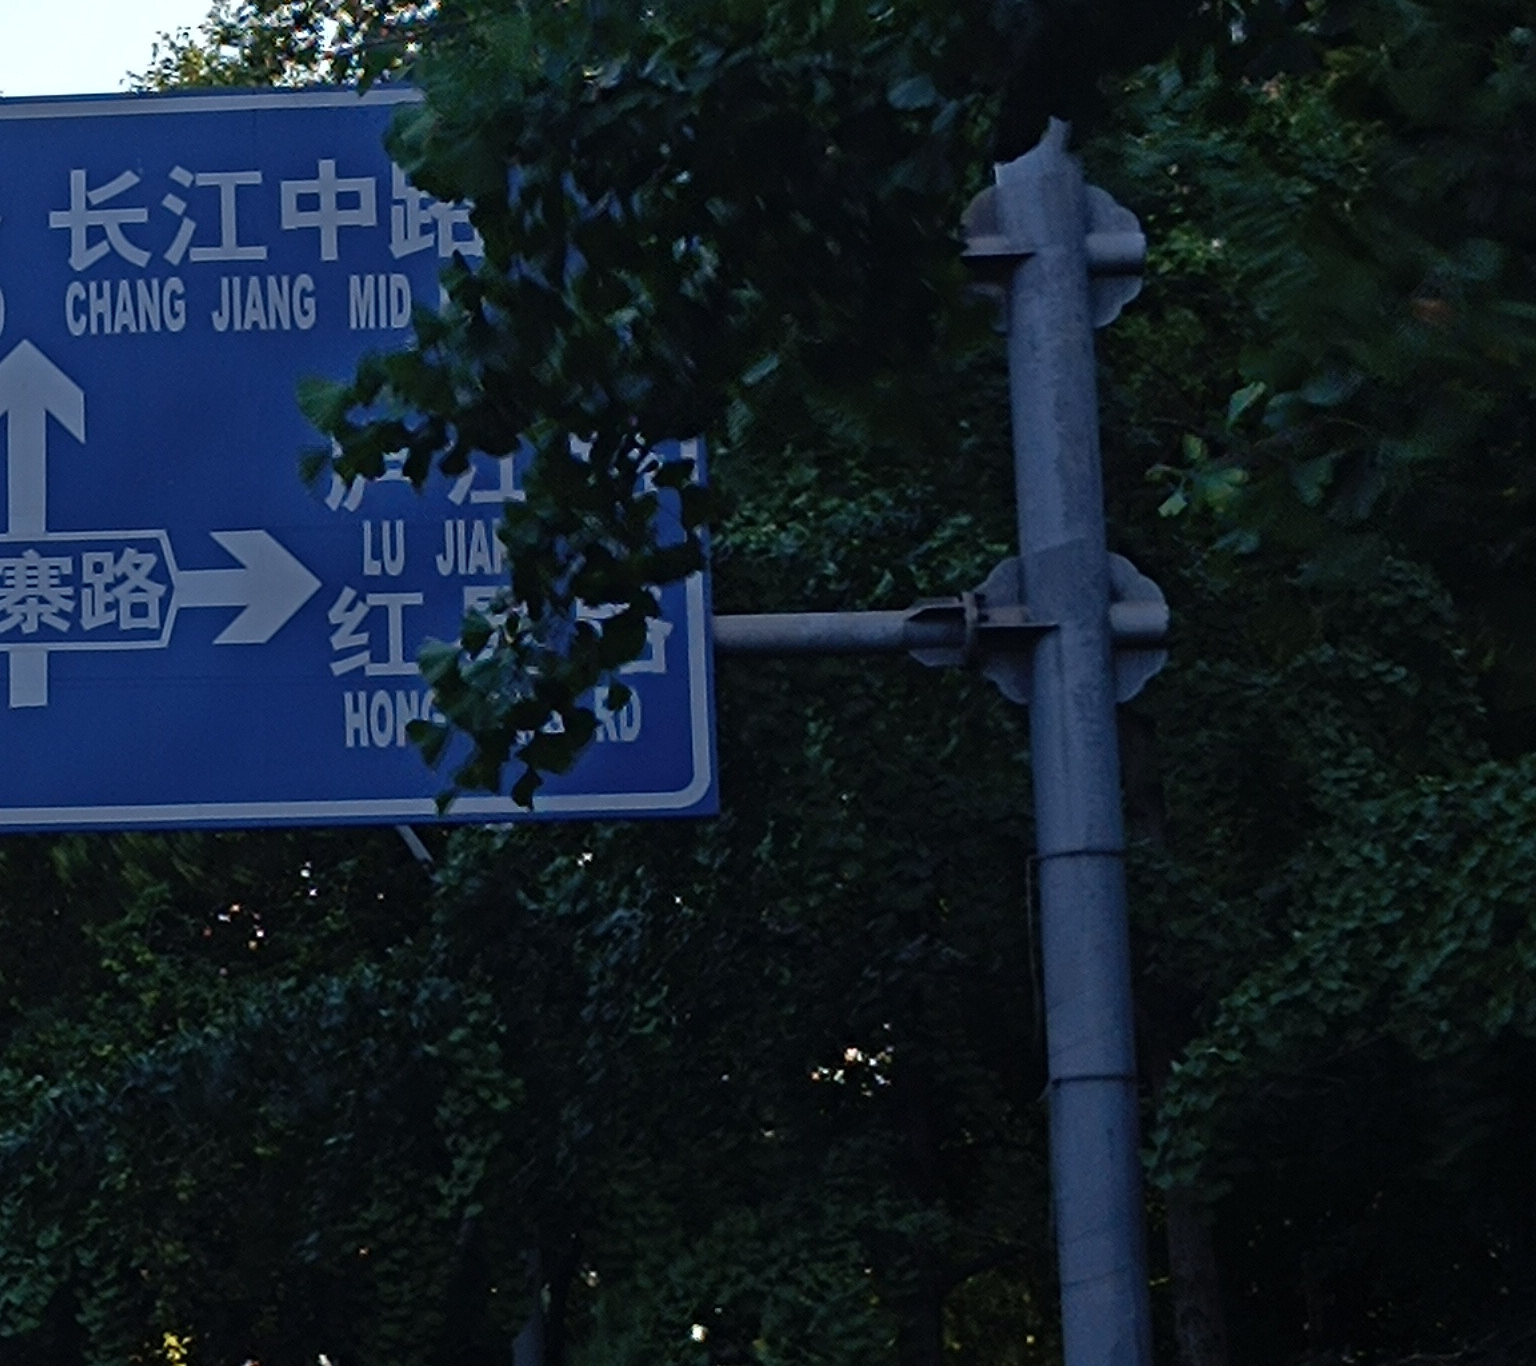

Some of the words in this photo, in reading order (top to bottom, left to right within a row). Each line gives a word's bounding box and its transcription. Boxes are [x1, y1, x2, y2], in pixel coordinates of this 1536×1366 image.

[49, 159, 486, 272] 长江中路
[65, 275, 186, 336] CHANG
[211, 273, 317, 332] JIANG
[349, 273, 412, 330] MID
[363, 519, 406, 576] LU
[435, 518, 509, 576] JIA
